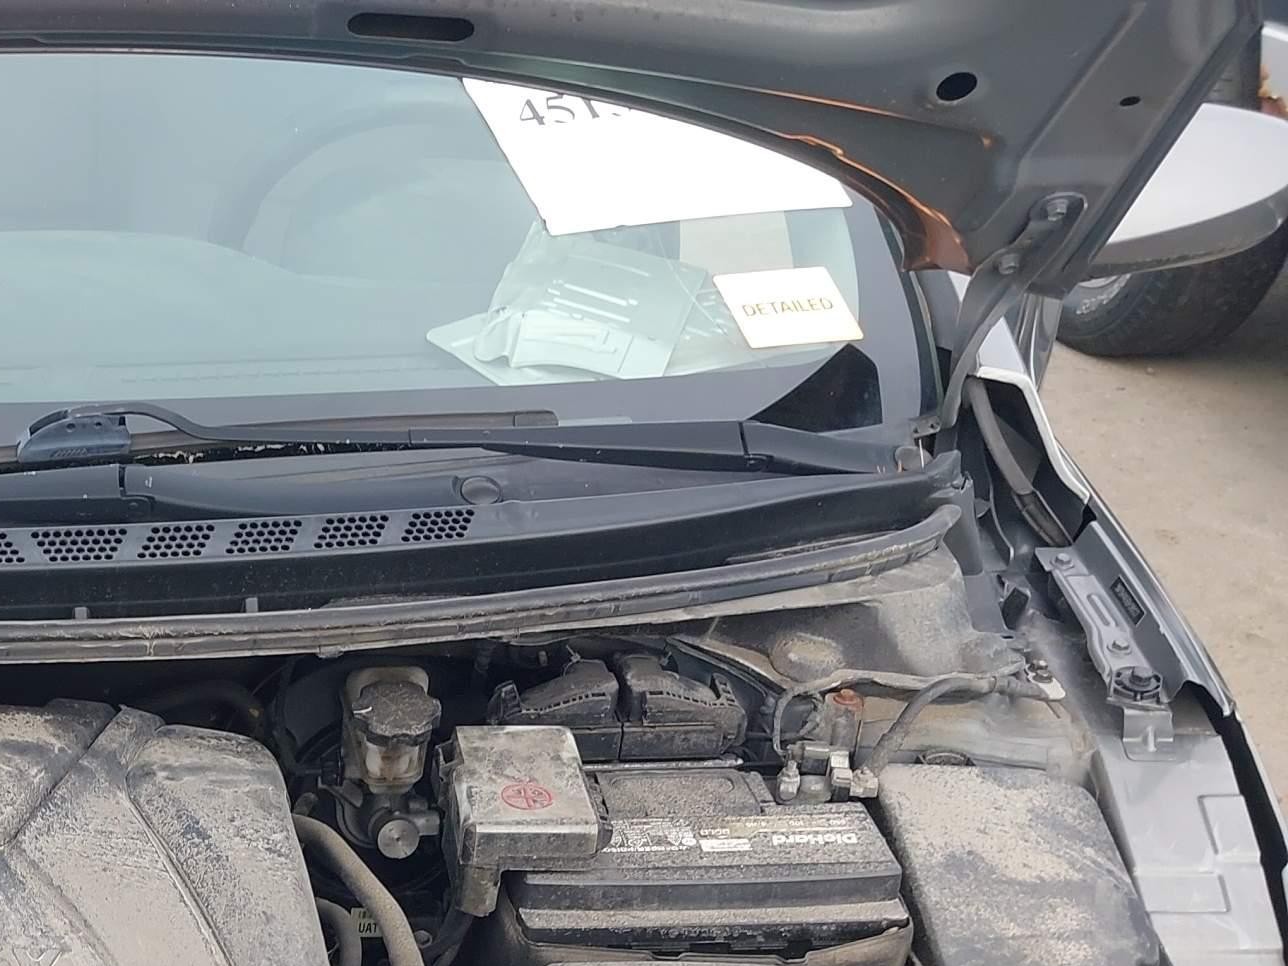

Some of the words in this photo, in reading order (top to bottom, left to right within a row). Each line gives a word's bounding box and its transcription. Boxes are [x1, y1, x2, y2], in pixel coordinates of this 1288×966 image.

[520, 93, 621, 125] 451
[741, 297, 835, 317] DETAILED
[771, 832, 858, 846] DieHard
